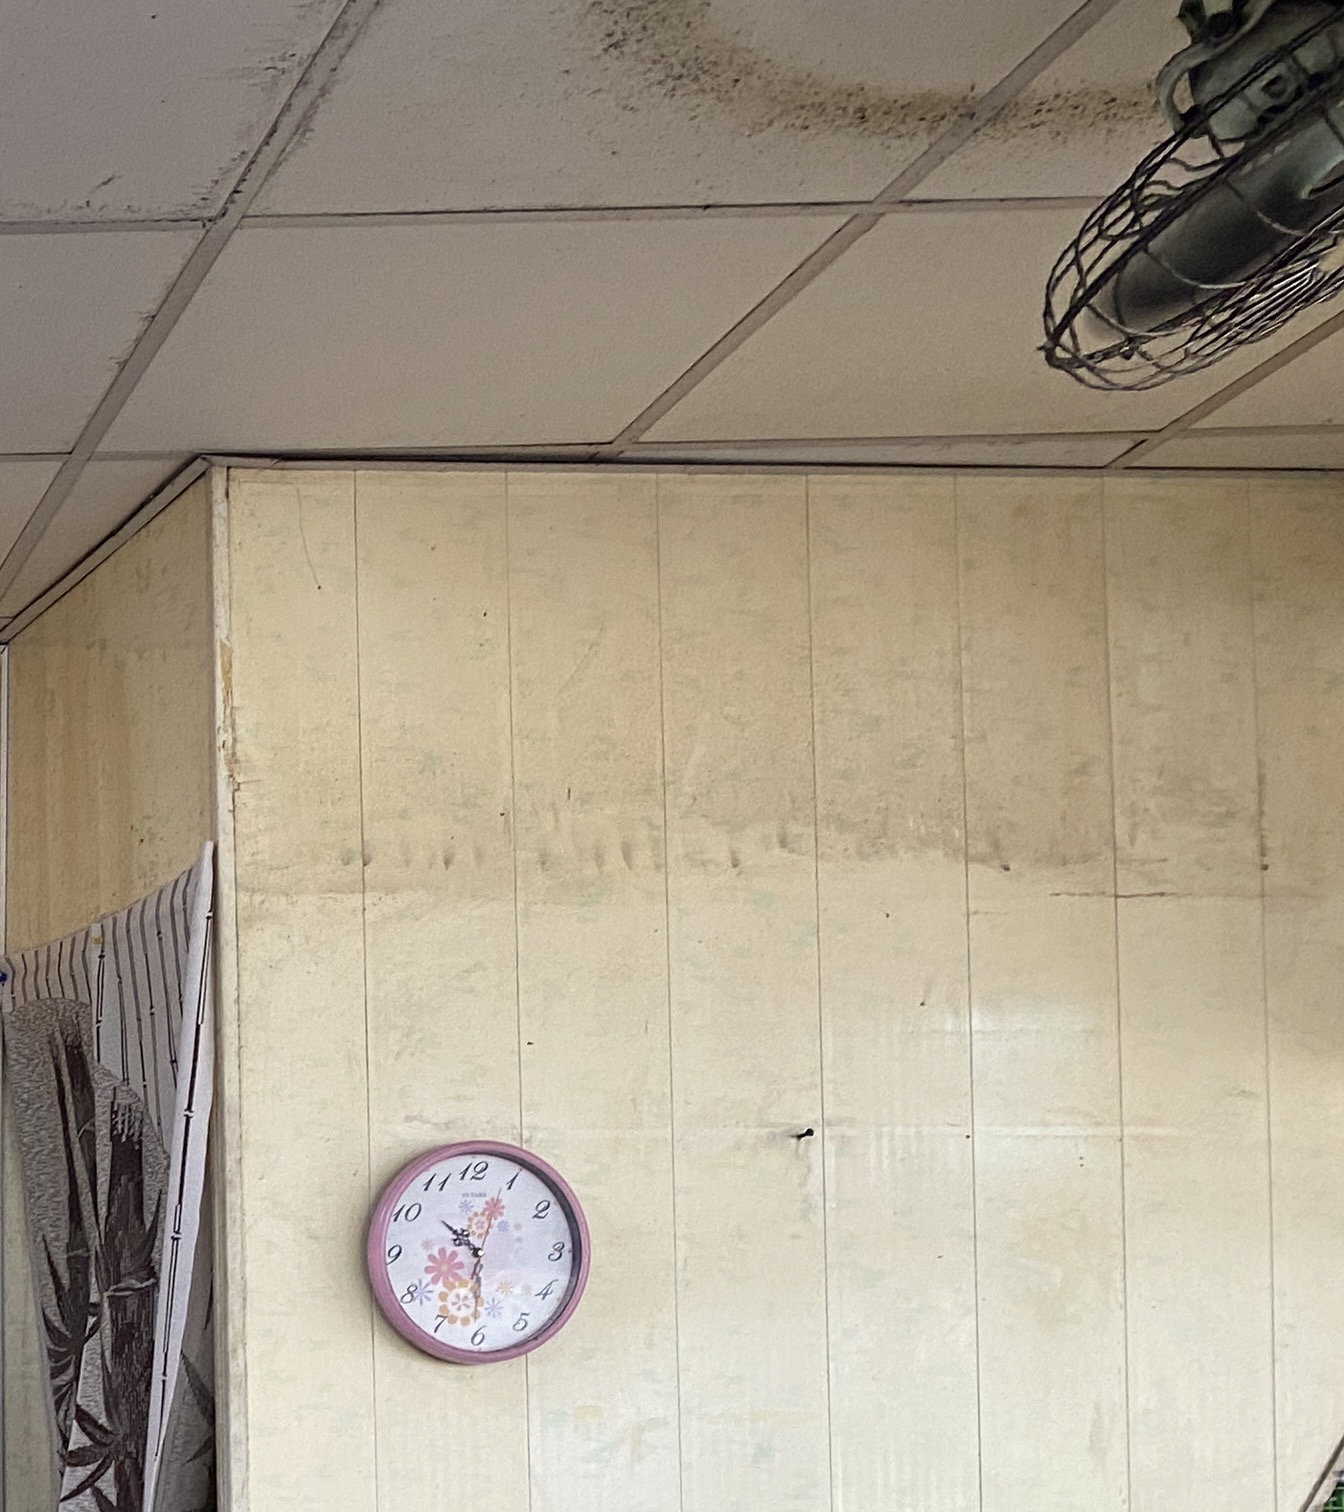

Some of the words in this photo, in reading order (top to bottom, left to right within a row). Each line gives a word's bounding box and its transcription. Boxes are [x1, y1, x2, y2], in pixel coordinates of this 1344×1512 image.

[459, 1161, 489, 1181] 12
[506, 1169, 522, 1190] 1
[423, 1173, 452, 1191] 11
[393, 1203, 422, 1222] 10
[532, 1200, 551, 1220] 2
[386, 1244, 403, 1265] 9
[548, 1242, 565, 1262] 3
[399, 1284, 419, 1304] 8
[534, 1279, 559, 1301] 4
[433, 1314, 449, 1334] 7
[511, 1312, 531, 1332] 5
[470, 1325, 487, 1346] 6
